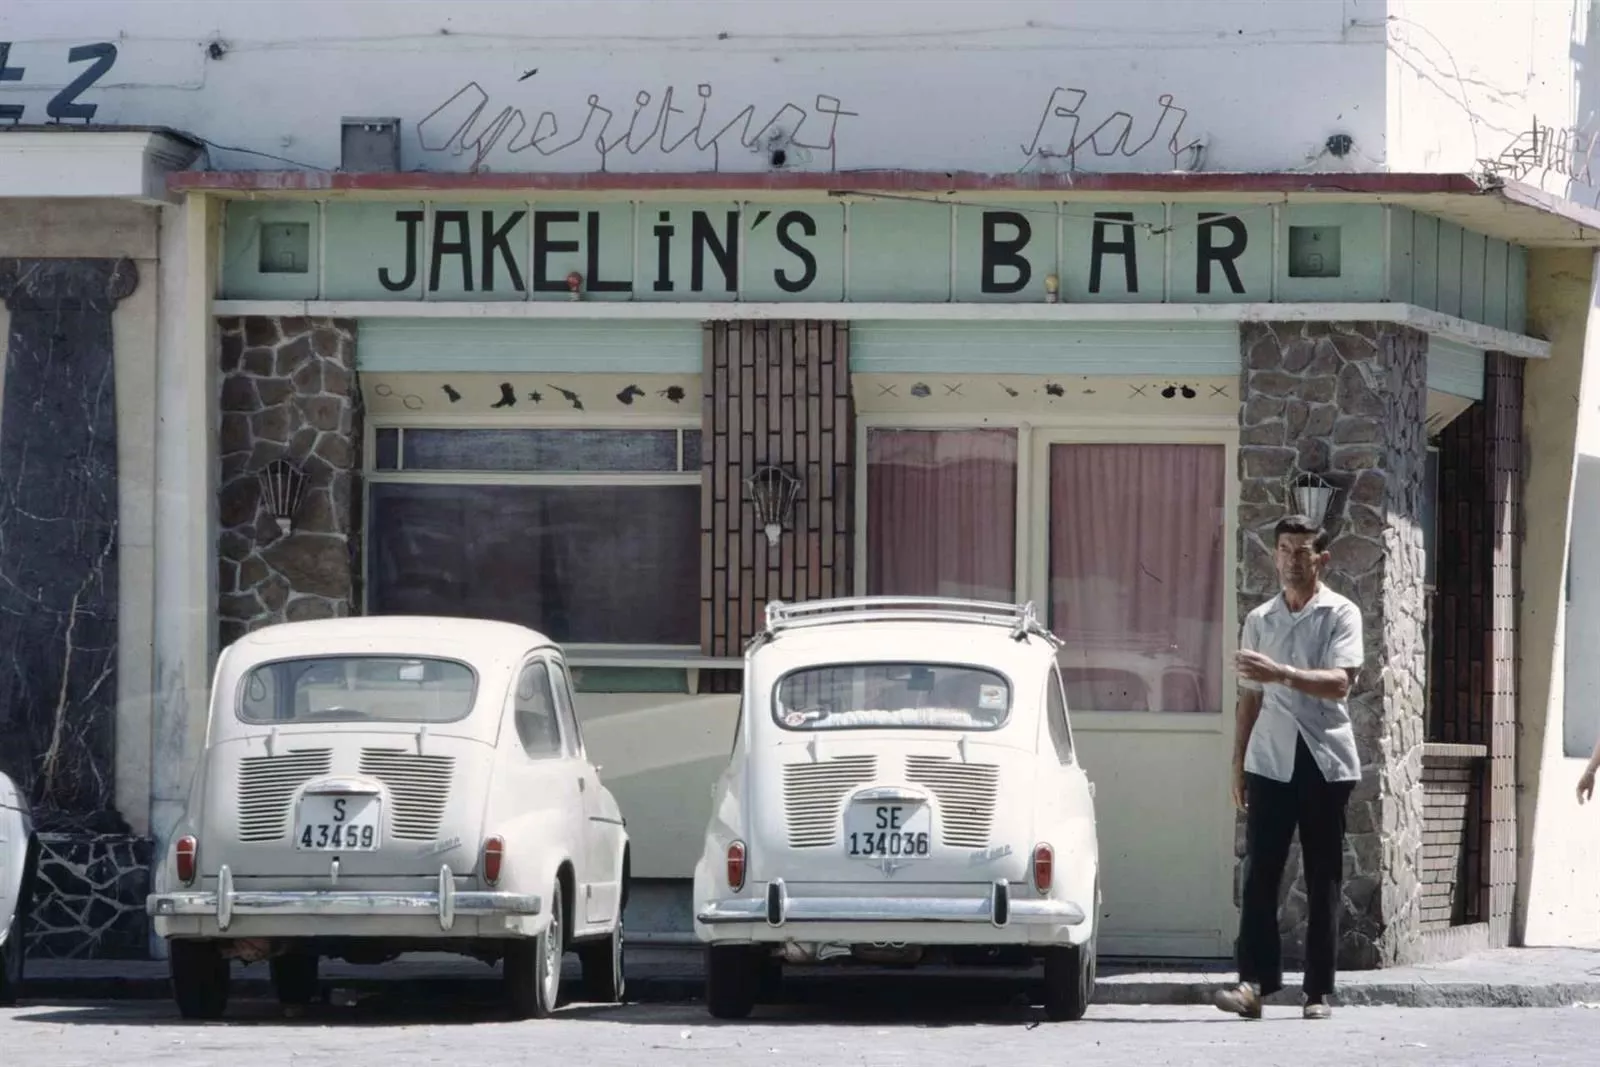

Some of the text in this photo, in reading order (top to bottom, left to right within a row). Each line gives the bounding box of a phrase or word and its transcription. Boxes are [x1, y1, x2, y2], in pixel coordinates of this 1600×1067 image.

[1020, 87, 1200, 157] Bar
[981, 211, 1248, 294] BAR
[333, 799, 347, 822] S
[875, 806, 902, 830] SE
[301, 825, 375, 849] 43459
[849, 832, 929, 857] 134036
